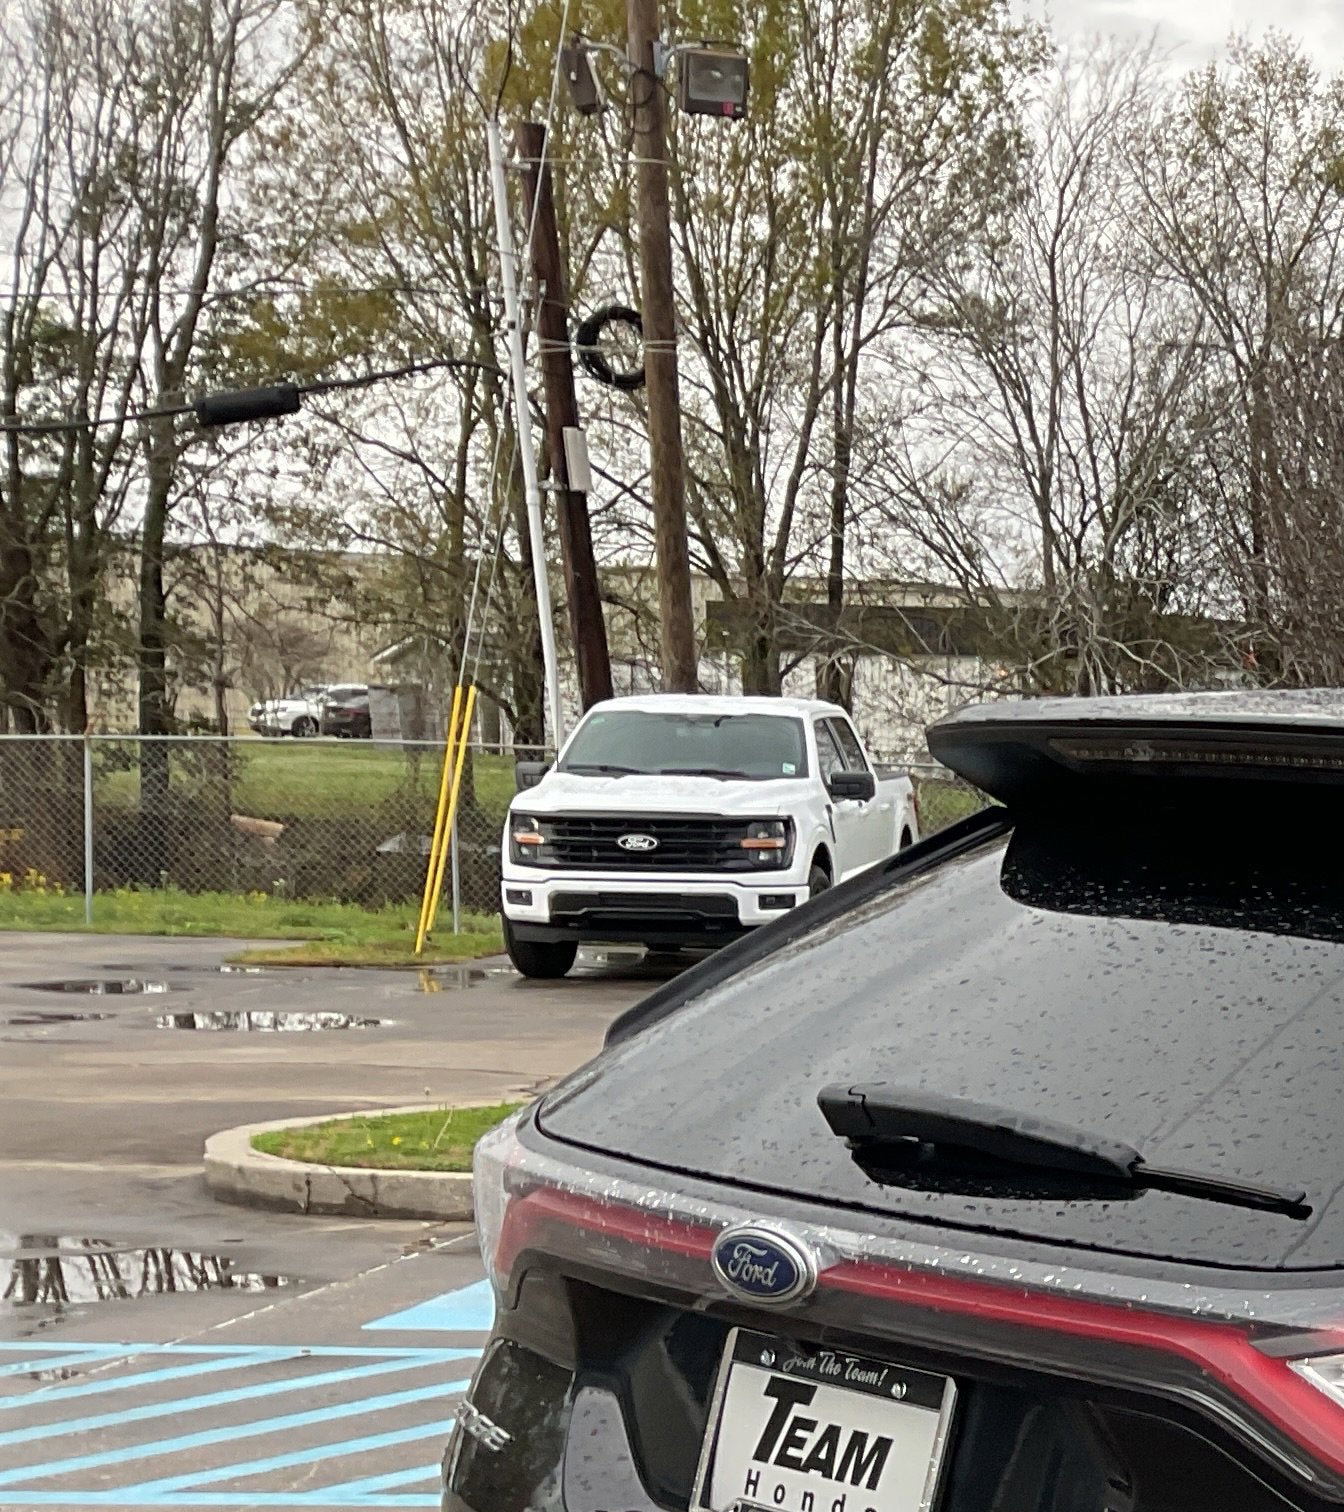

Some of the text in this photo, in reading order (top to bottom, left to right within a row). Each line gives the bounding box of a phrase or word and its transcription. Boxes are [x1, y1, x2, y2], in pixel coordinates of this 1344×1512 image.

[726, 1242, 778, 1288] Ford
[819, 1351, 842, 1376] The
[844, 1357, 889, 1388] Team!
[752, 1375, 895, 1492] TEAM
